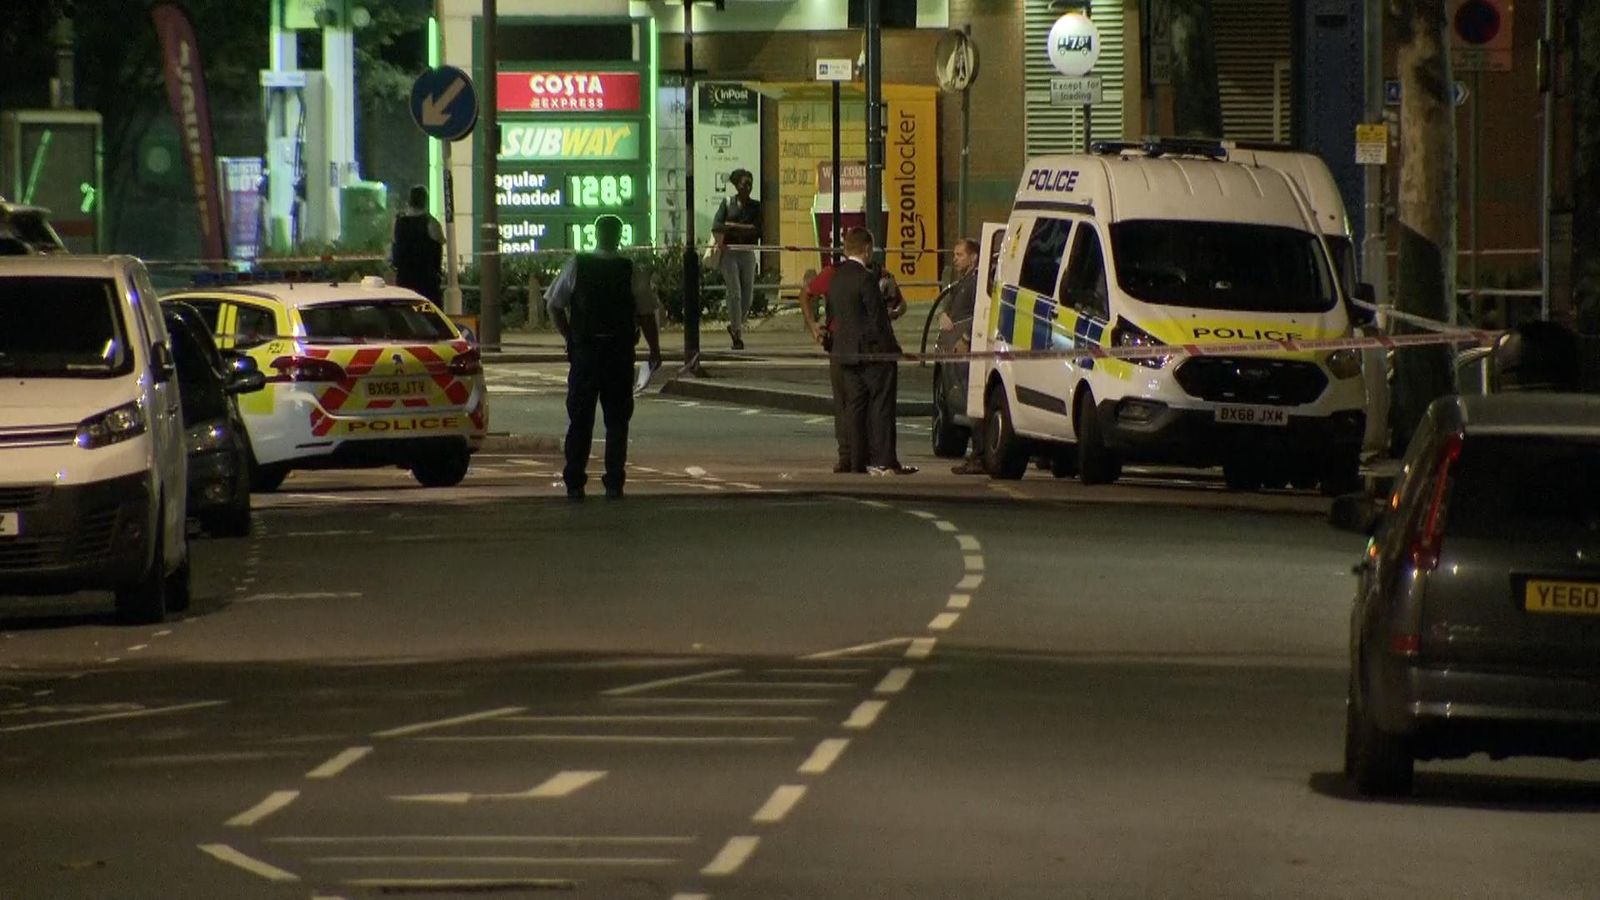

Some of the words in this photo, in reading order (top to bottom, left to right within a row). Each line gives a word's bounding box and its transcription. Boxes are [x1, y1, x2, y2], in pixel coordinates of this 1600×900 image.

[529, 74, 604, 96] COSTA
[1053, 81, 1082, 91] Except
[1087, 80, 1100, 89] for
[720, 88, 748, 100] InPost
[1061, 91, 1092, 101] loading
[542, 98, 604, 109] EXPRESS
[502, 125, 631, 156] SUBWAY
[495, 171, 546, 189] egular
[1027, 169, 1079, 192] POLICE
[495, 189, 560, 205] nleaded
[571, 175, 632, 206] 128.9
[498, 239, 536, 253] iesel
[1193, 328, 1302, 342] POLICE
[347, 417, 460, 432] POLICE
[1537, 586, 1599, 609] YE60
